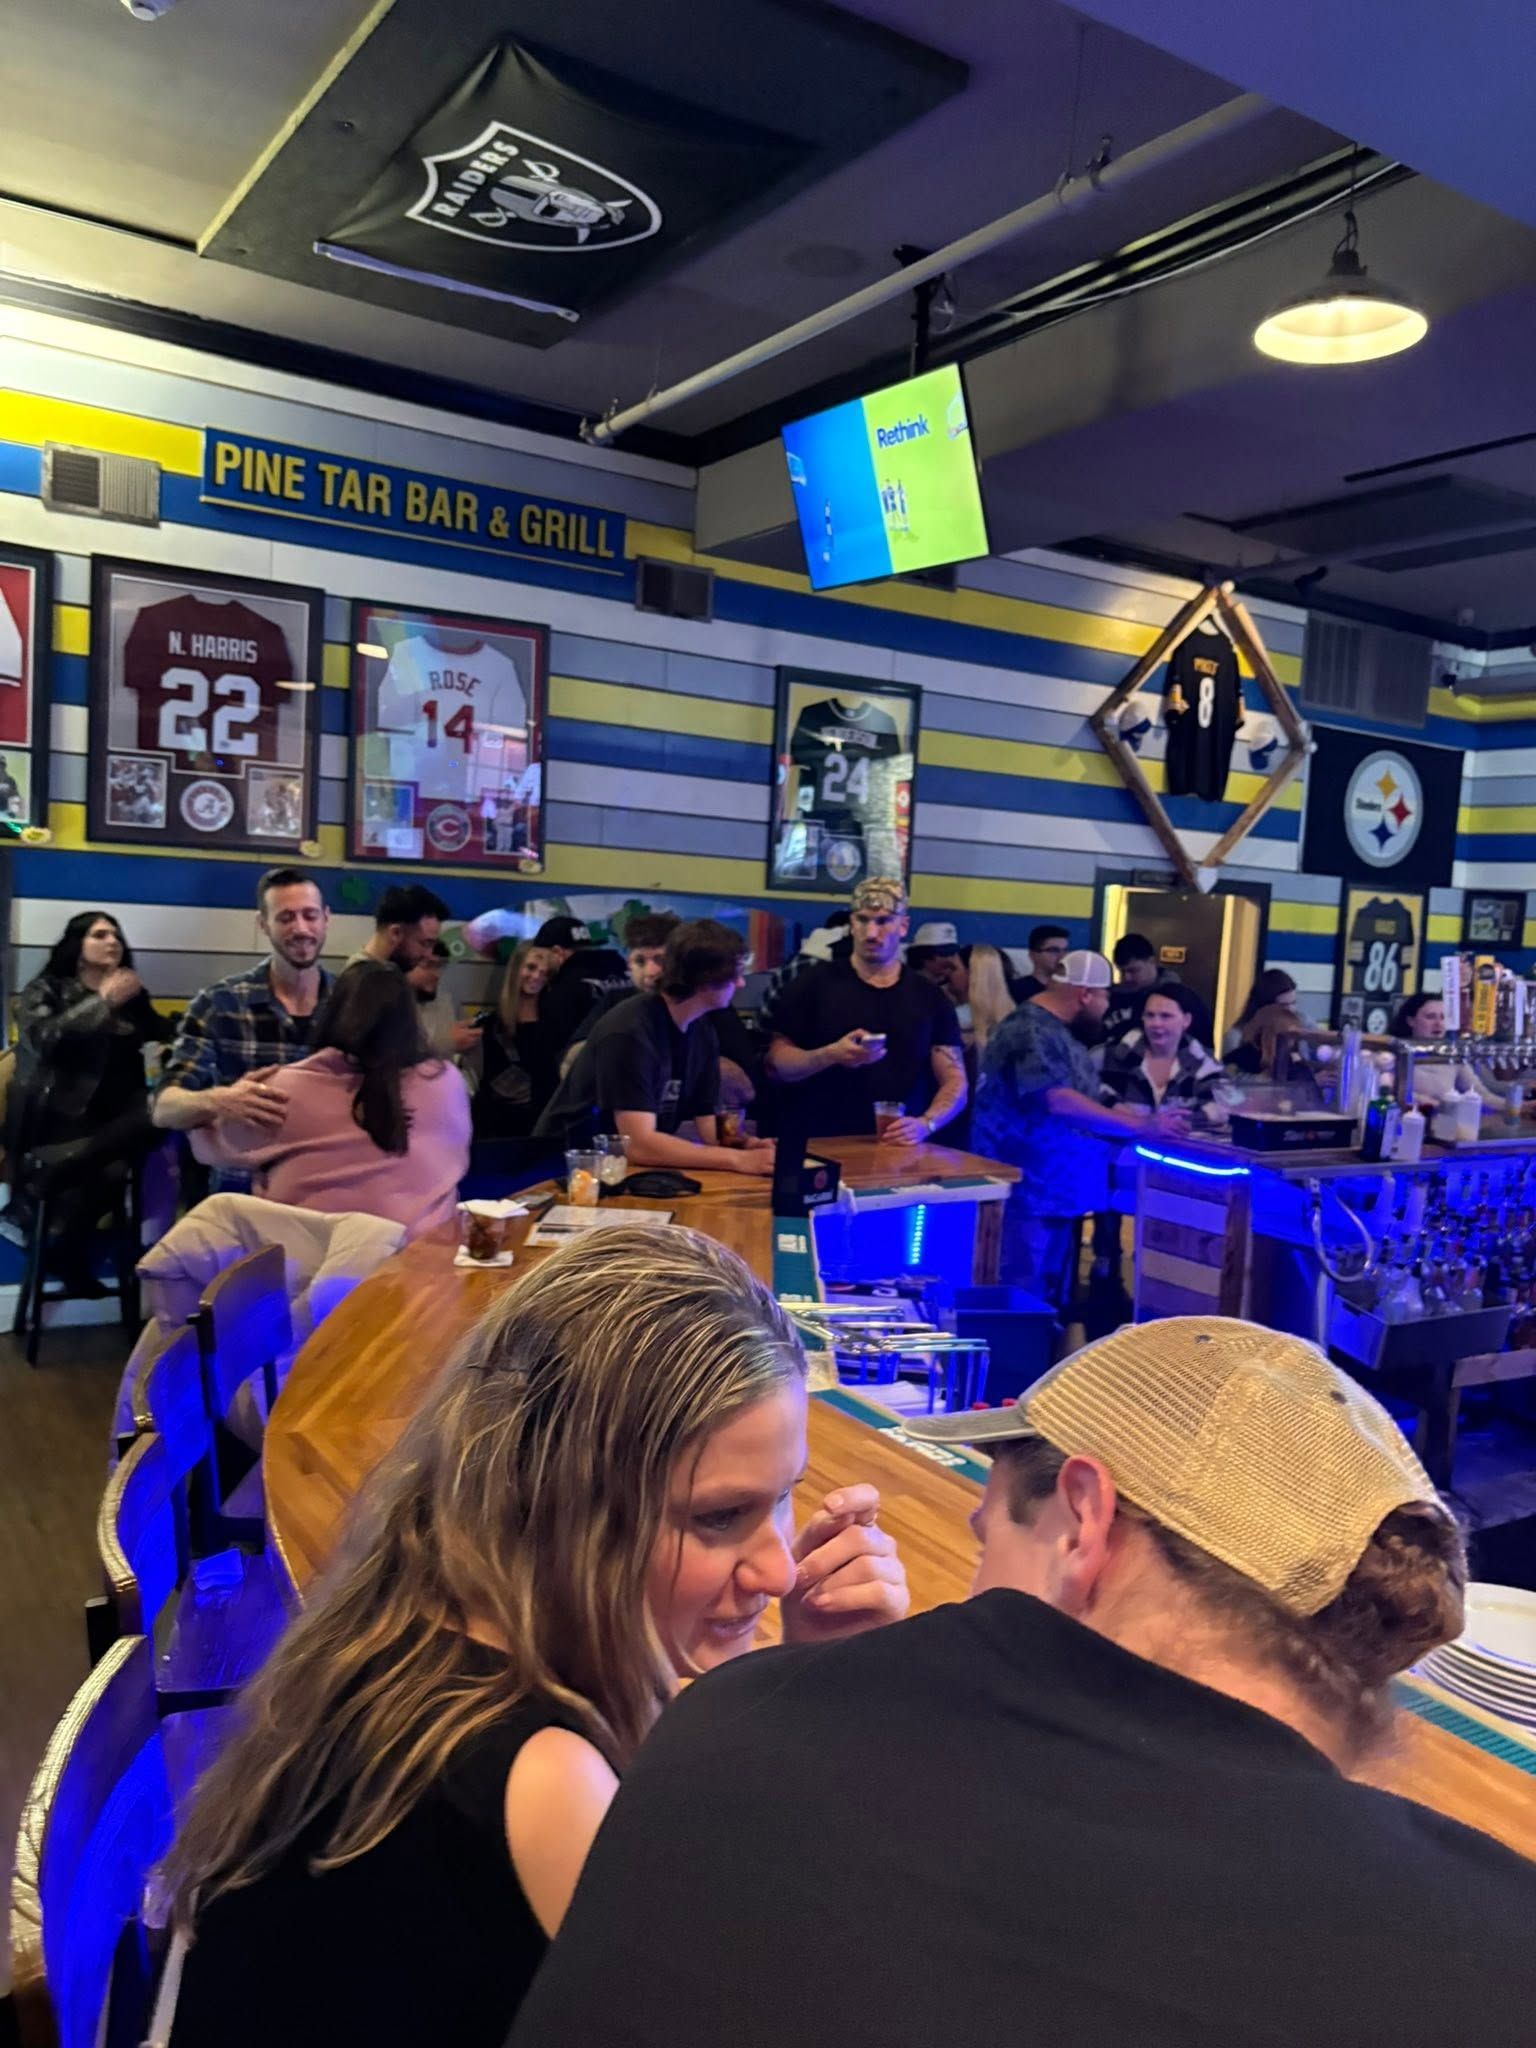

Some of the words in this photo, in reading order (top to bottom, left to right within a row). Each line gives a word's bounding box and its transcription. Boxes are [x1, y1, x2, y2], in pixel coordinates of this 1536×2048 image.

[432, 140, 520, 218] RAIDERS
[876, 413, 930, 449] Rethink
[214, 440, 306, 501] PINE
[317, 462, 392, 518] TAR
[405, 479, 479, 534] BAR
[488, 505, 510, 540] &
[519, 503, 616, 560] GRILL
[167, 630, 188, 656] N.
[191, 633, 259, 665] HARRIS
[428, 669, 481, 698] ROSE
[1197, 676, 1215, 729] 8
[158, 666, 262, 757] 22
[422, 699, 475, 755] 14
[821, 752, 871, 805] 24
[1363, 940, 1400, 993] 86
